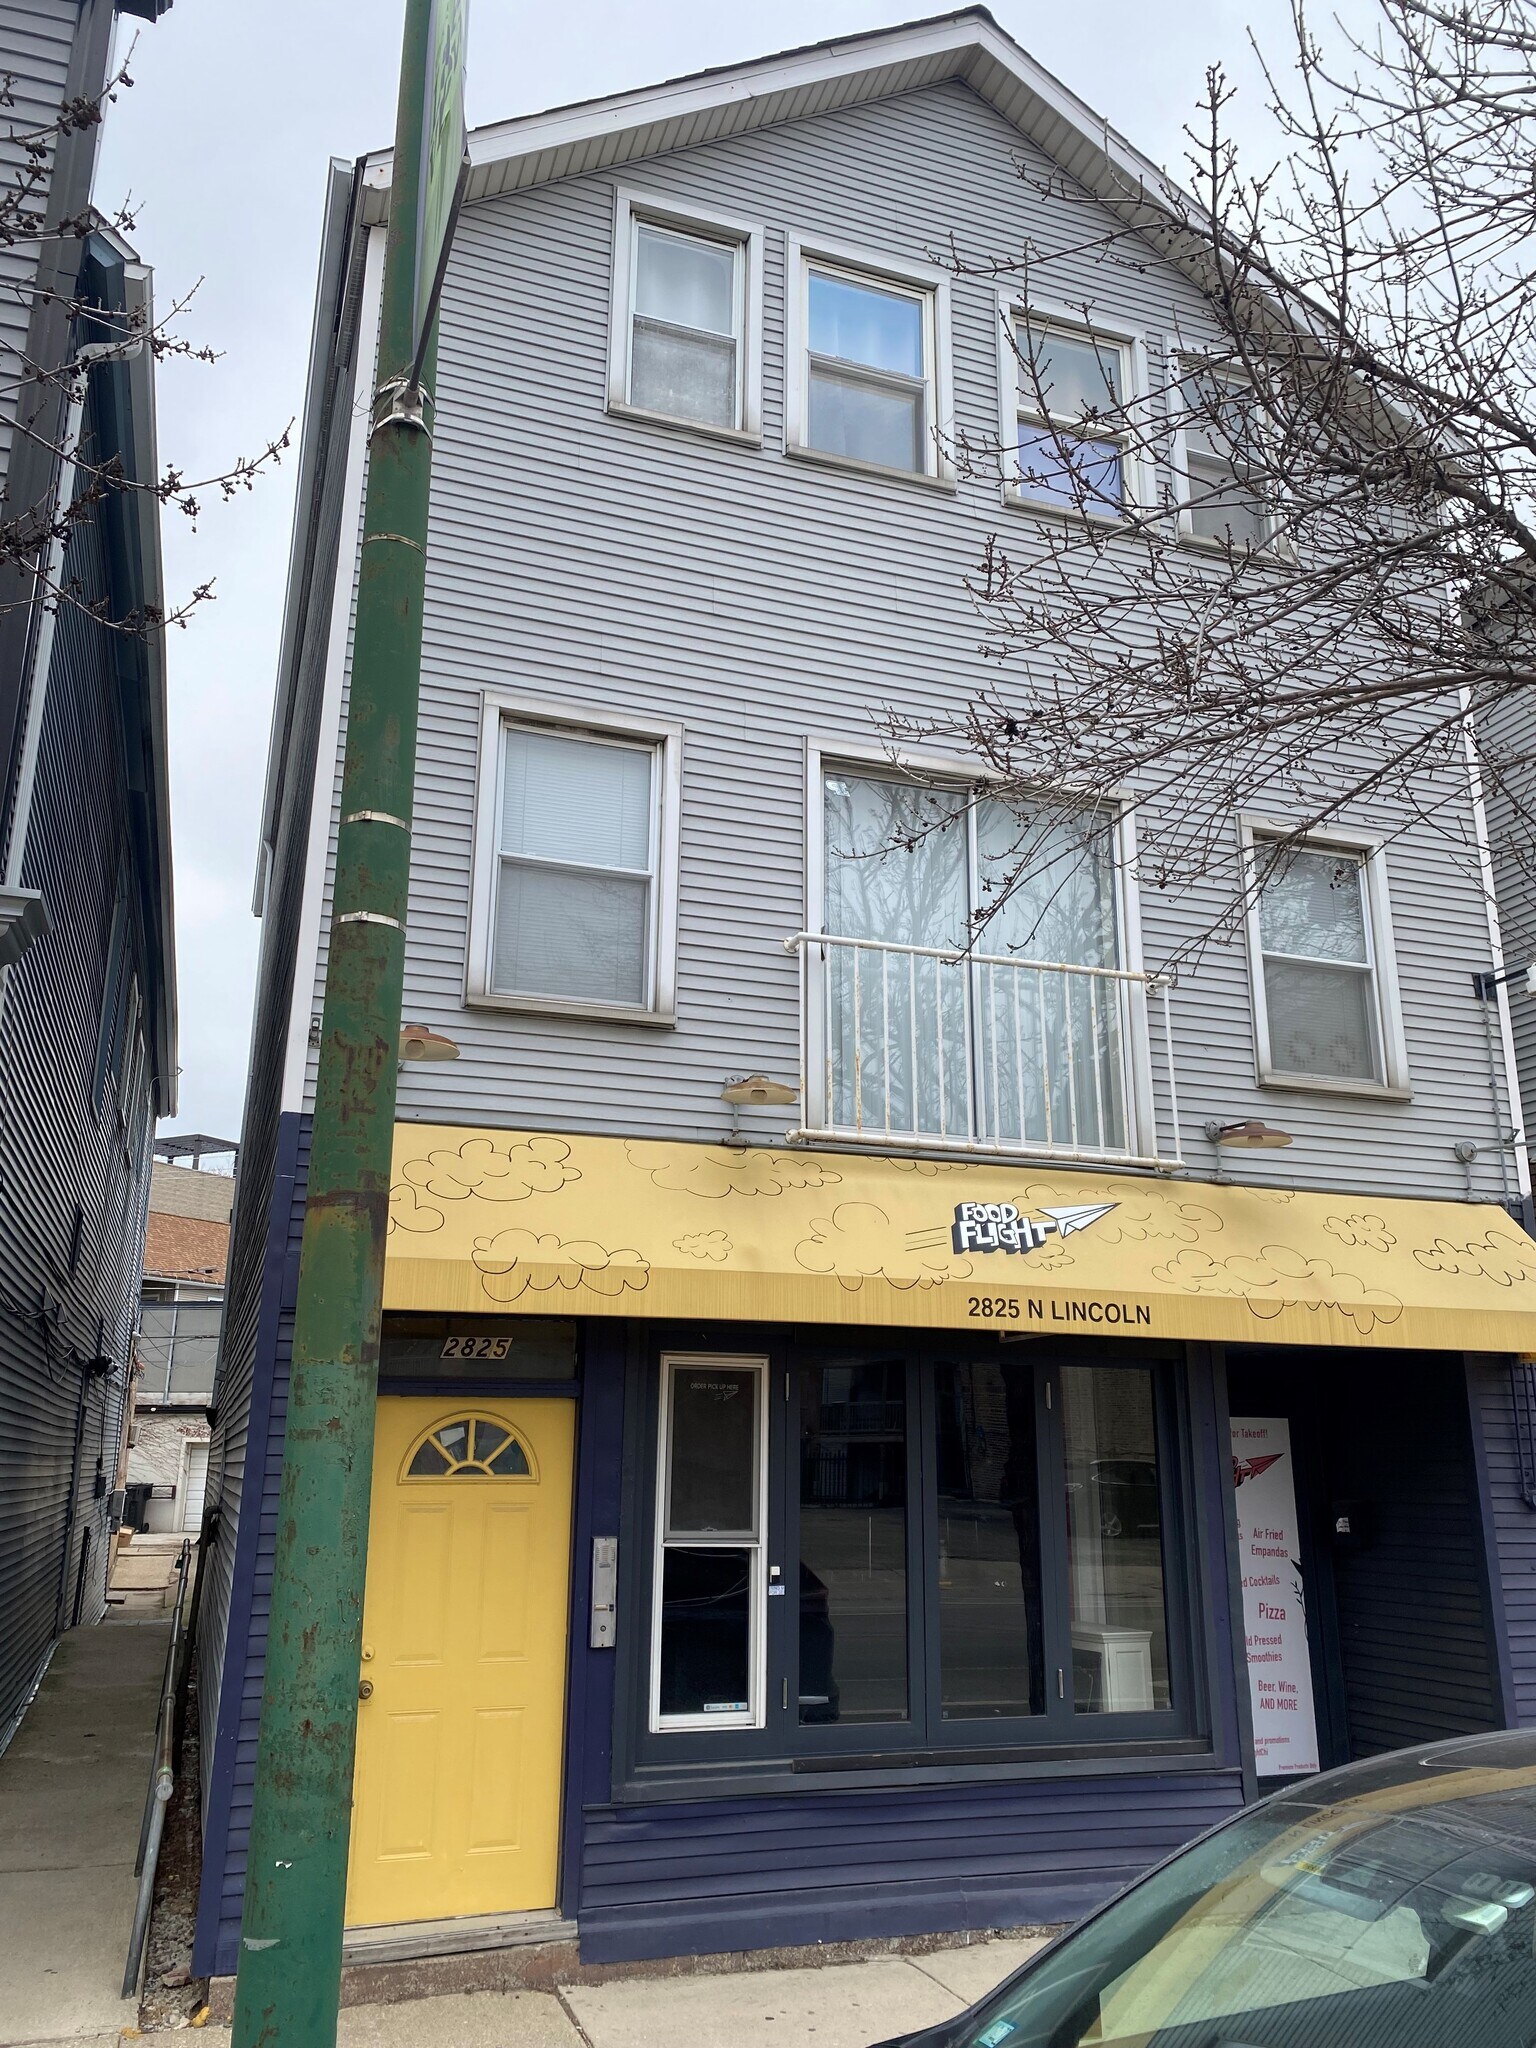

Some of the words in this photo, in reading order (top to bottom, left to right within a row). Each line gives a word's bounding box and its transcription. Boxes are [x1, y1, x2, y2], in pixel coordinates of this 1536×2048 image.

[956, 1202, 1020, 1223] FOOD
[954, 1217, 1057, 1252] FLIGHT
[968, 1297, 1020, 1318] 2825
[1028, 1299, 1043, 1319] N
[1052, 1300, 1151, 1325] LINCOLN
[443, 1337, 509, 1358] 2825
[690, 1382, 707, 1390] ORDER
[1231, 1430, 1239, 1438] or
[1241, 1428, 1269, 1438] Takeoff!
[1253, 1528, 1264, 1539] Air
[1265, 1529, 1284, 1540] Fried
[1251, 1545, 1289, 1558] Empandas
[1249, 1575, 1280, 1587] Cocktails
[1258, 1602, 1286, 1620] Pizza
[1254, 1634, 1282, 1646] Pressed
[1246, 1651, 1283, 1663] Smoothies
[1258, 1679, 1277, 1692] Beer,
[1278, 1680, 1299, 1694] Wine,
[1260, 1698, 1275, 1710] AND
[1276, 1699, 1298, 1711] MORE
